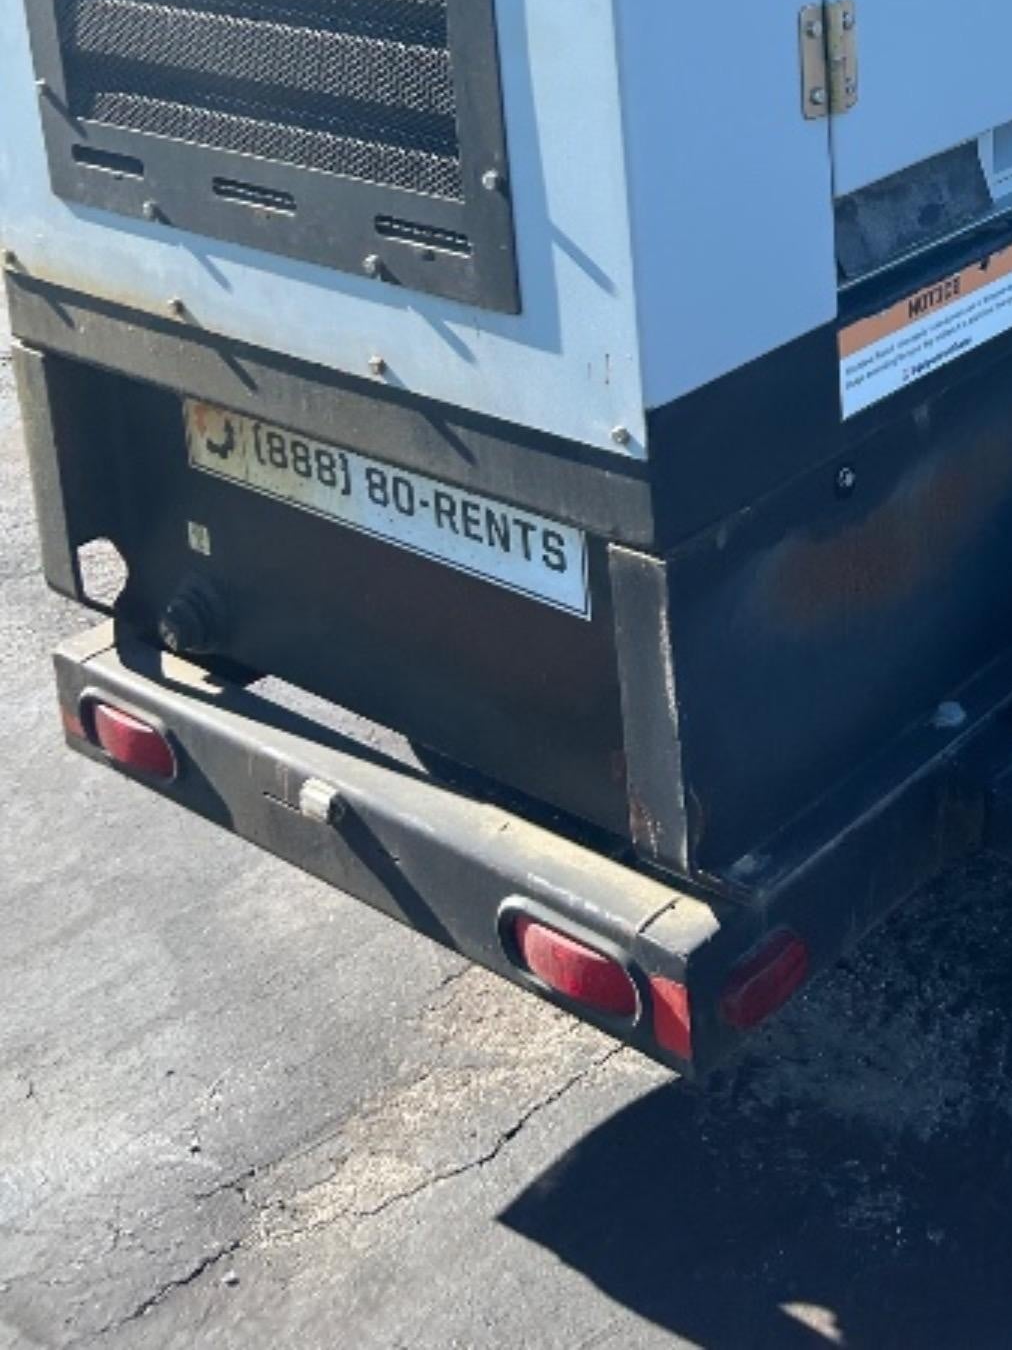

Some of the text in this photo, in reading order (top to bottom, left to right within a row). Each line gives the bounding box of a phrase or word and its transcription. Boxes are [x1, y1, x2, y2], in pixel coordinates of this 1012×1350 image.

[907, 275, 962, 320] NOTICE
[253, 424, 569, 574] (888) 80-RENTS
